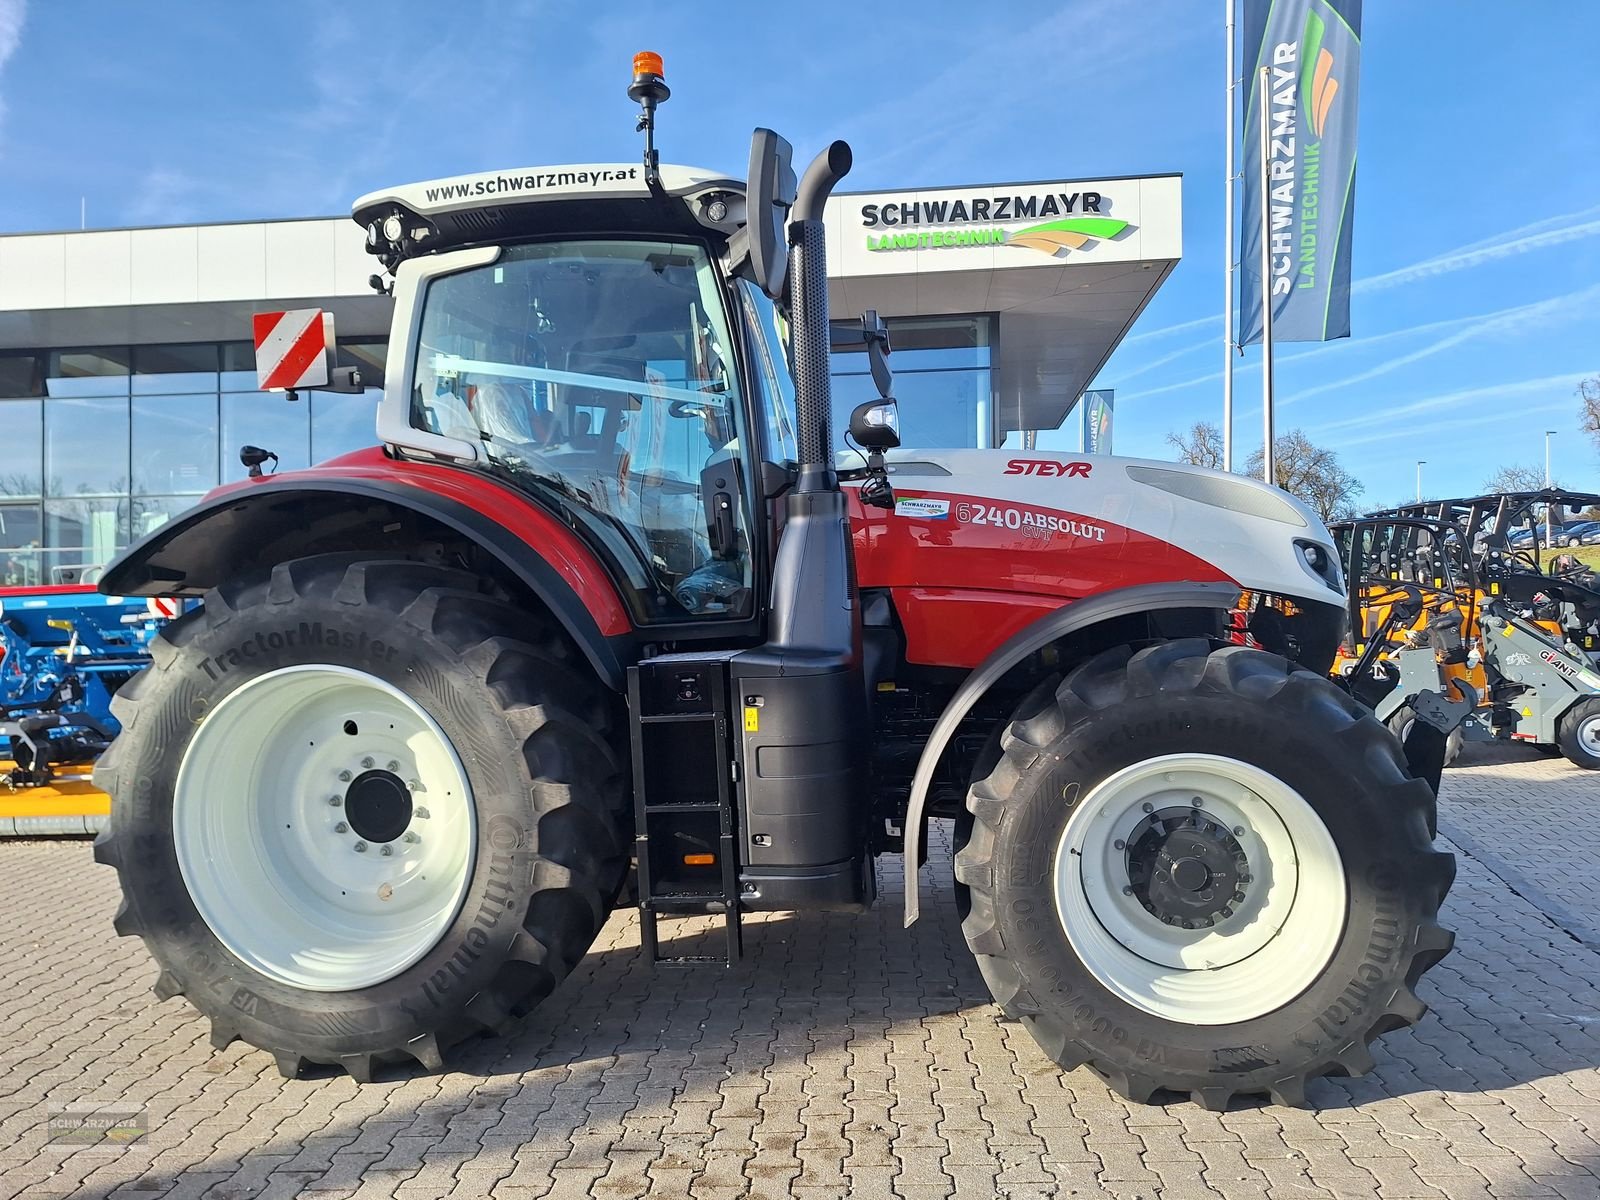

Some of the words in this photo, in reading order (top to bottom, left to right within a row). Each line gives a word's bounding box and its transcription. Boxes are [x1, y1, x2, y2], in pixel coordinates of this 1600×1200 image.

[425, 166, 637, 203] www.schwarzmayr.at
[1271, 40, 1298, 297] SCHWARZMAYR
[861, 191, 1103, 227] SCHWARZMAYR
[1298, 141, 1321, 290] LANDTECHNIK
[866, 228, 1005, 251] LANDTECHNIK
[1003, 459, 1093, 479] STEYR
[1021, 511, 1105, 542] ABSOLUT
[1021, 525, 1052, 541] CVT
[197, 622, 401, 681] TractorMaster
[420, 814, 525, 1008] Continental
